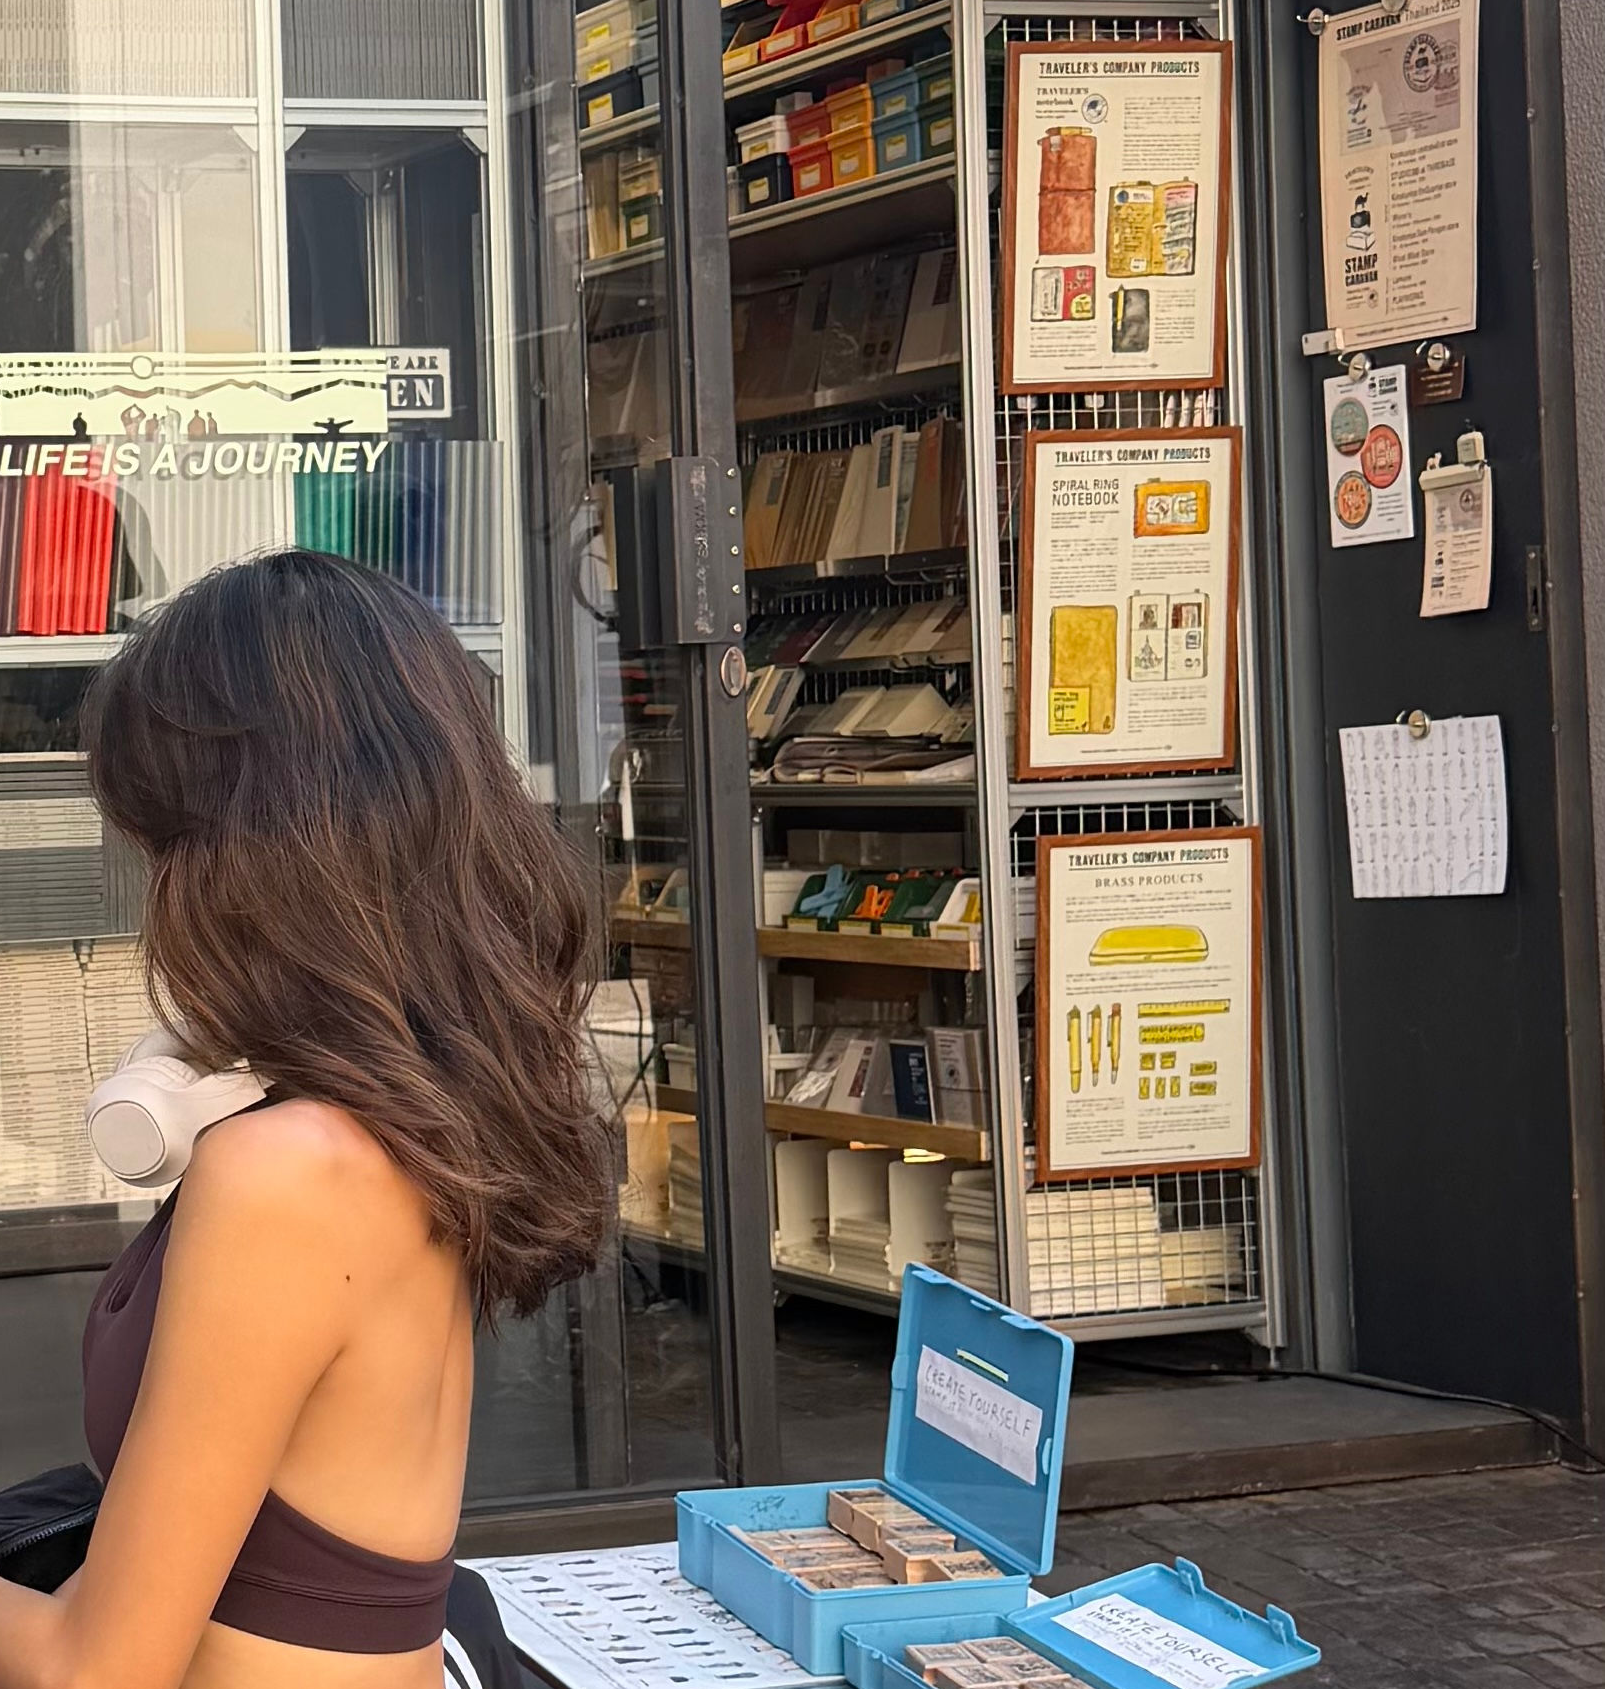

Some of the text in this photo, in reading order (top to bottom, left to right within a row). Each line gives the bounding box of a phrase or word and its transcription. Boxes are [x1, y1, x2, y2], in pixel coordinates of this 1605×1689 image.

[1336, 24, 1363, 41] STAMP
[1039, 61, 1200, 74] TRAVELER'S COMPANY PRODUCTS
[1345, 253, 1378, 274] STAMP
[404, 356, 439, 370] ARE
[102, 443, 140, 476] IS
[149, 442, 179, 475] A
[191, 441, 388, 475] JOURNEY
[1055, 447, 1211, 463] TRAVELER'S COMPANY PRODUCTS
[1052, 478, 1119, 492] SPIRAL RING
[1052, 492, 1119, 506] NOTEBOOK
[1068, 847, 1229, 867] TRAVELER'S COMPANY PRODUCTS
[1095, 873, 1203, 888] BRASS PRODUCTS
[925, 1364, 1032, 1438] CREATE YOURSELF
[1099, 1603, 1158, 1636] CREATE
[1156, 1631, 1253, 1676] YOURSELF
